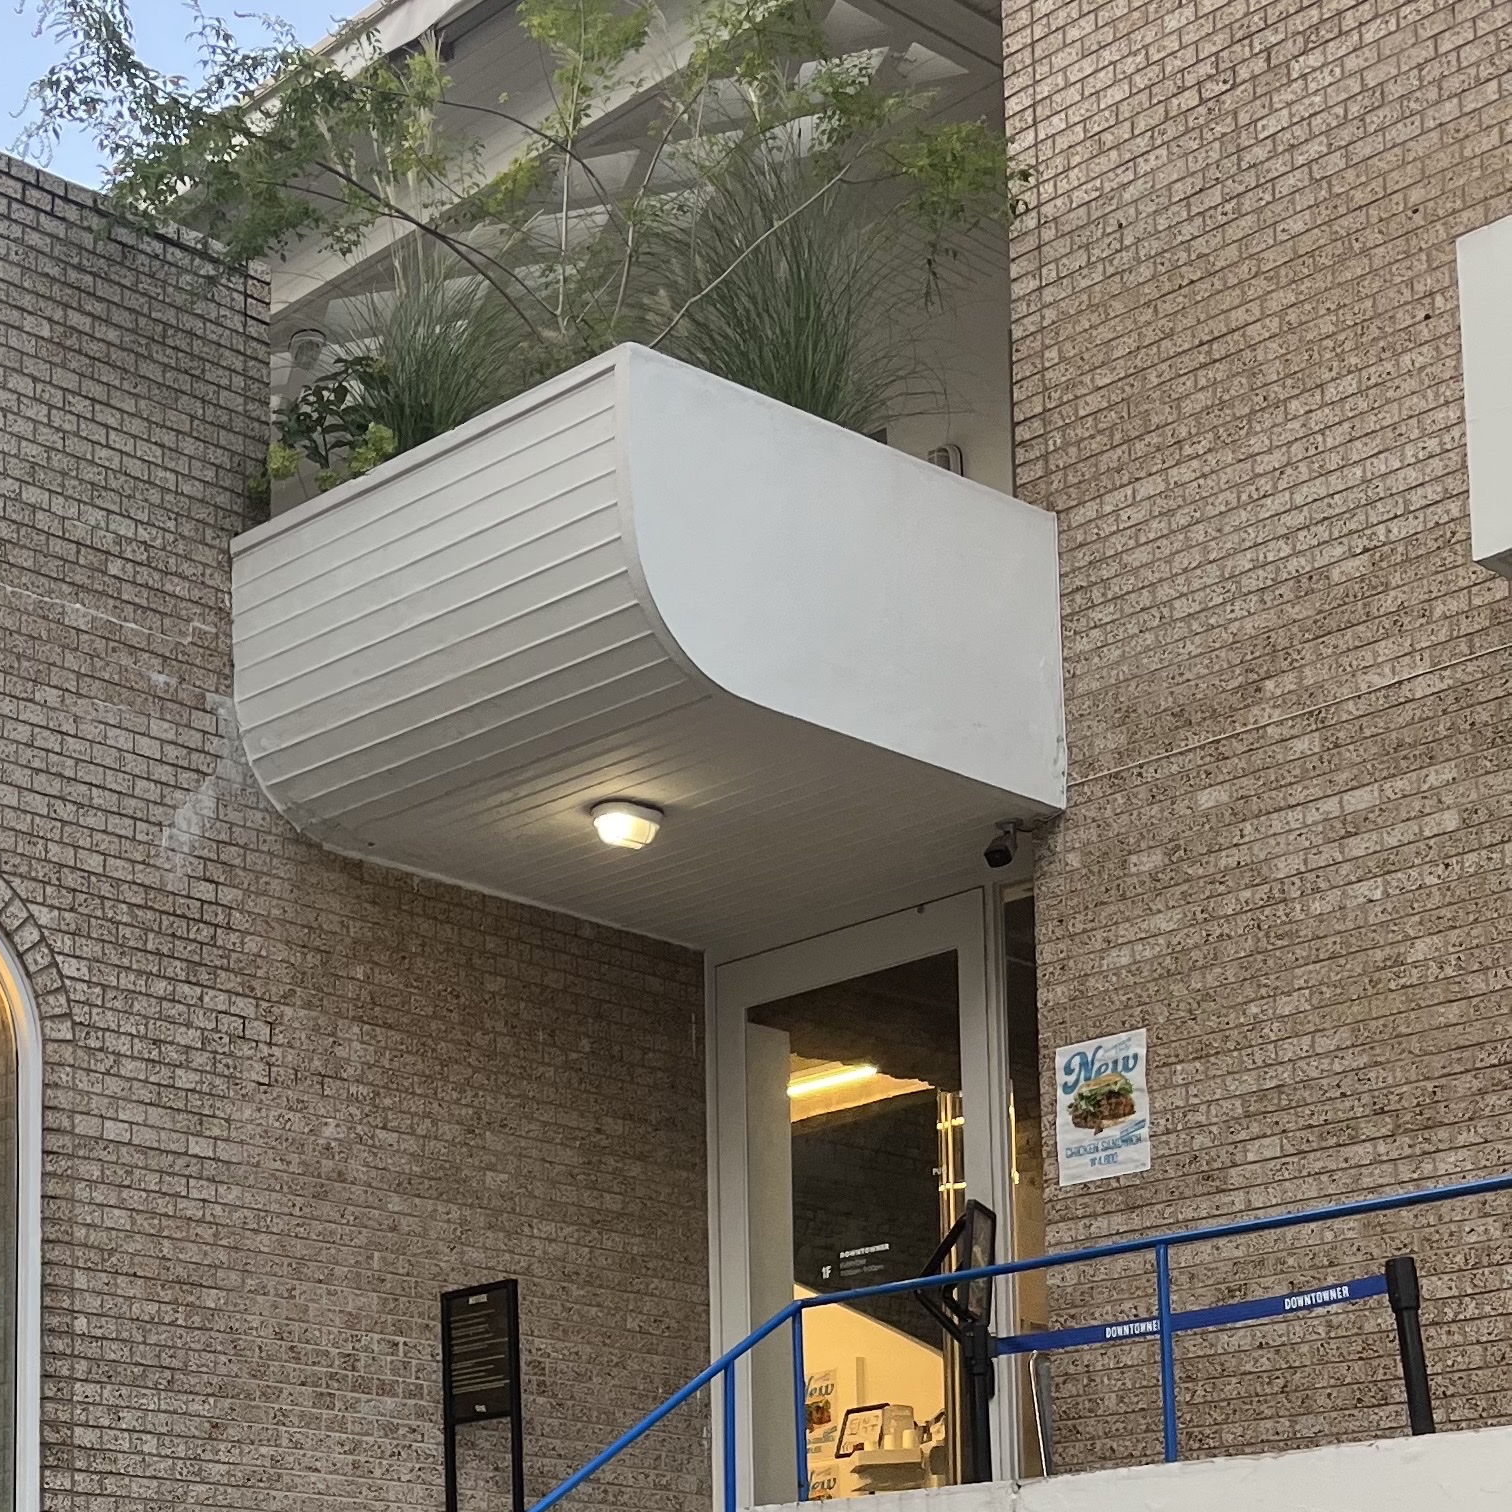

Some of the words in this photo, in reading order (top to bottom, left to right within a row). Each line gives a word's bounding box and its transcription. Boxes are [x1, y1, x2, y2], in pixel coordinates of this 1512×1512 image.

[1062, 1045, 1139, 1096] New
[1284, 1285, 1350, 1310] DOWNTOWNER
[1105, 1319, 1160, 1339] DOWNTOWNE
